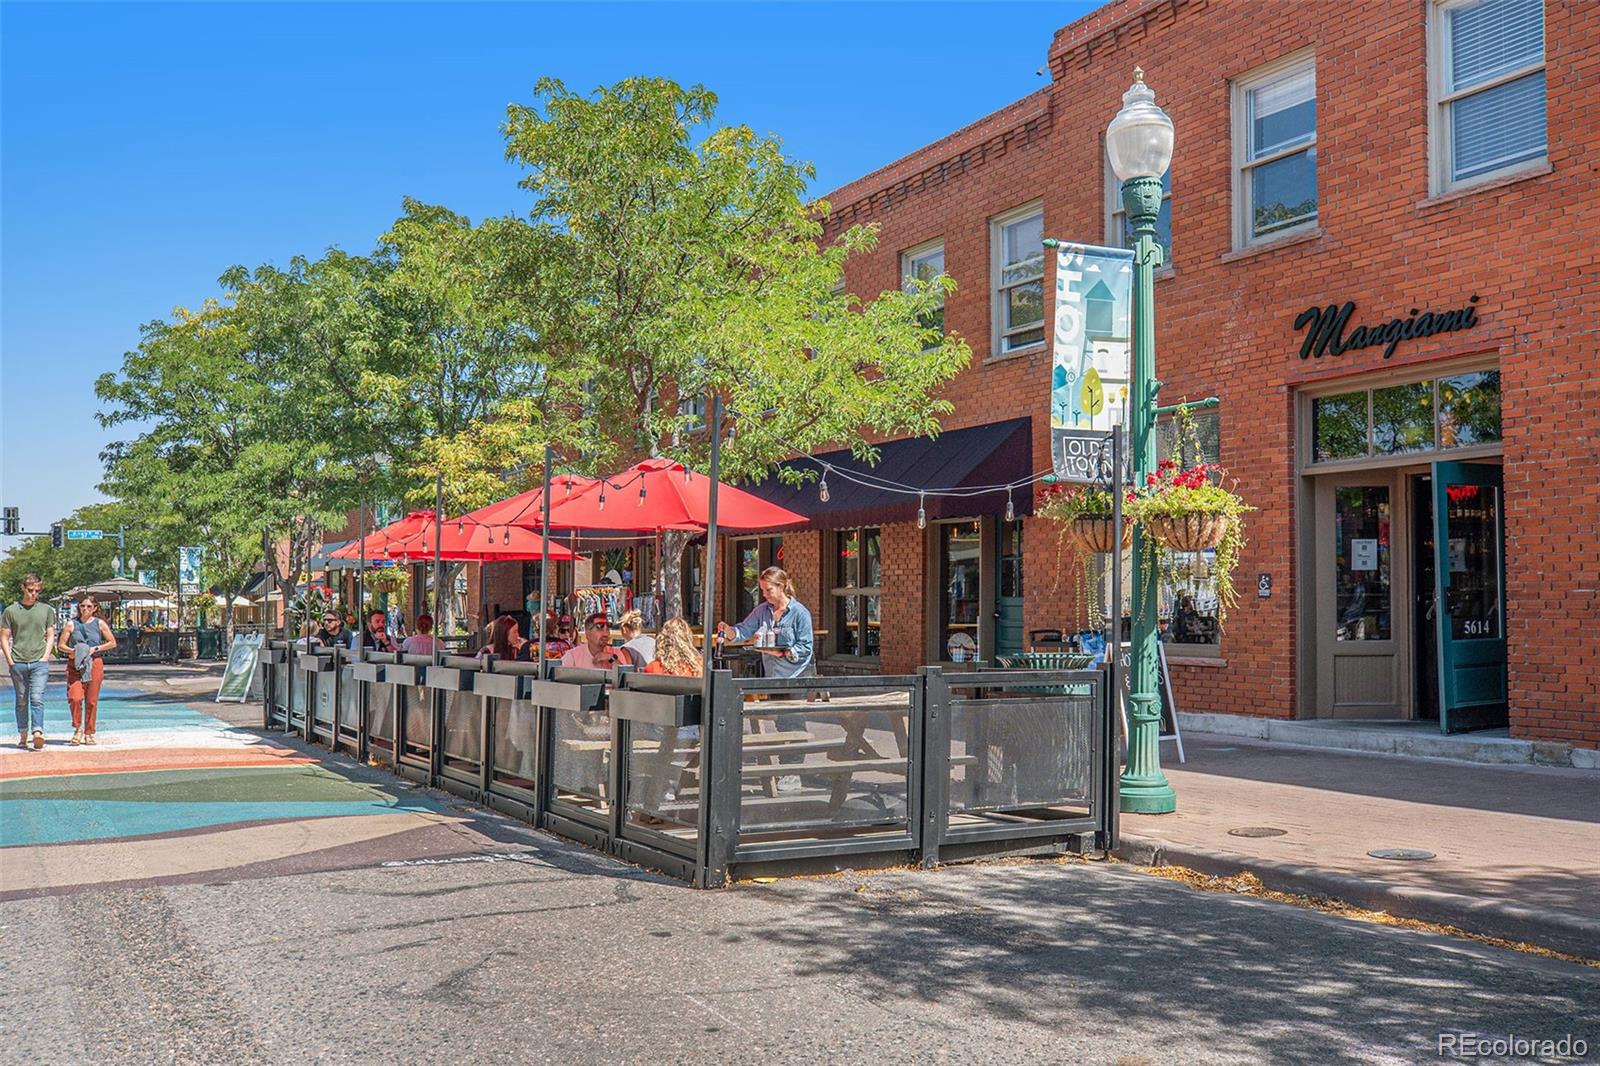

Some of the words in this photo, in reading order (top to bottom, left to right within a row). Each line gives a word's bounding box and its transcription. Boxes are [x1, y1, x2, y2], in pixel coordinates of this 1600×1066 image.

[1056, 244, 1083, 369] SHOP
[1294, 295, 1480, 359] Mangiami
[1068, 440, 1110, 456] OLDE
[1464, 620, 1490, 634] 5614
